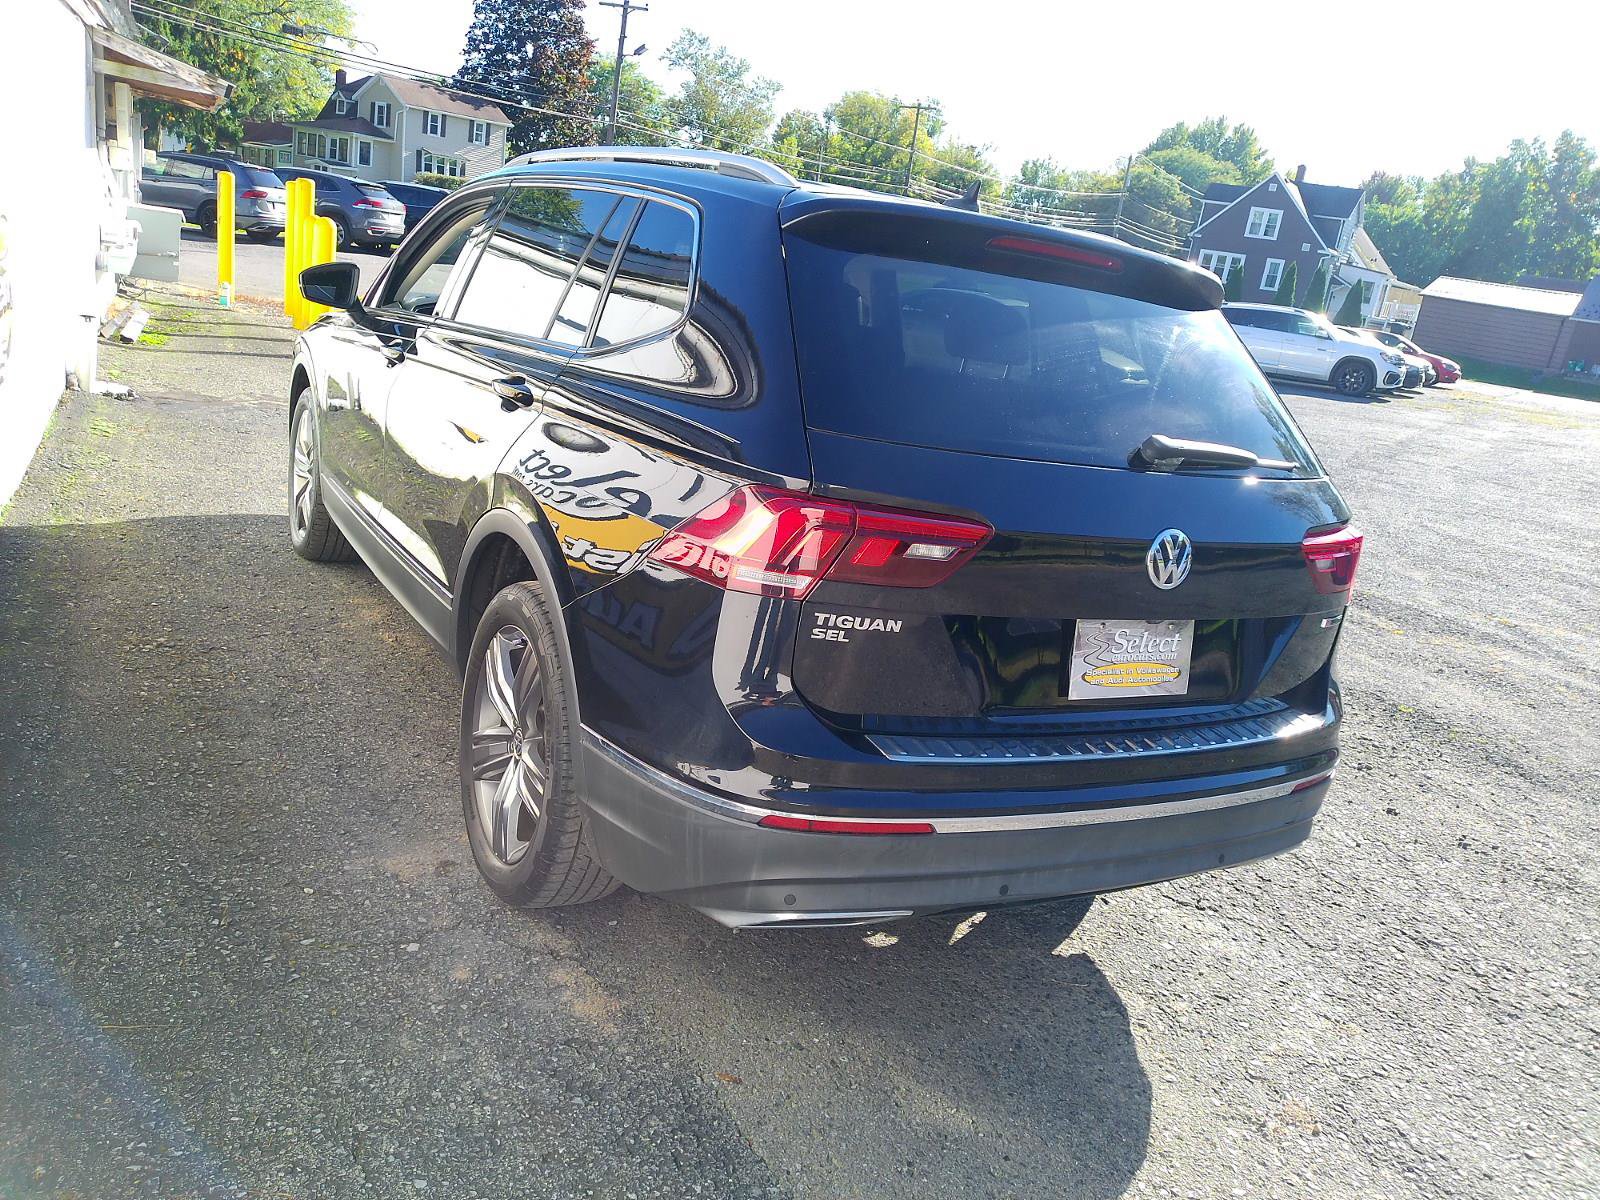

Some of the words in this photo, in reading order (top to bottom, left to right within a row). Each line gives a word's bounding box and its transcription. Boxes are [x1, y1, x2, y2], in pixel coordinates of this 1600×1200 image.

[814, 612, 903, 633] TIGUAN
[811, 628, 850, 642] SEL
[1111, 629, 1182, 653] Select
